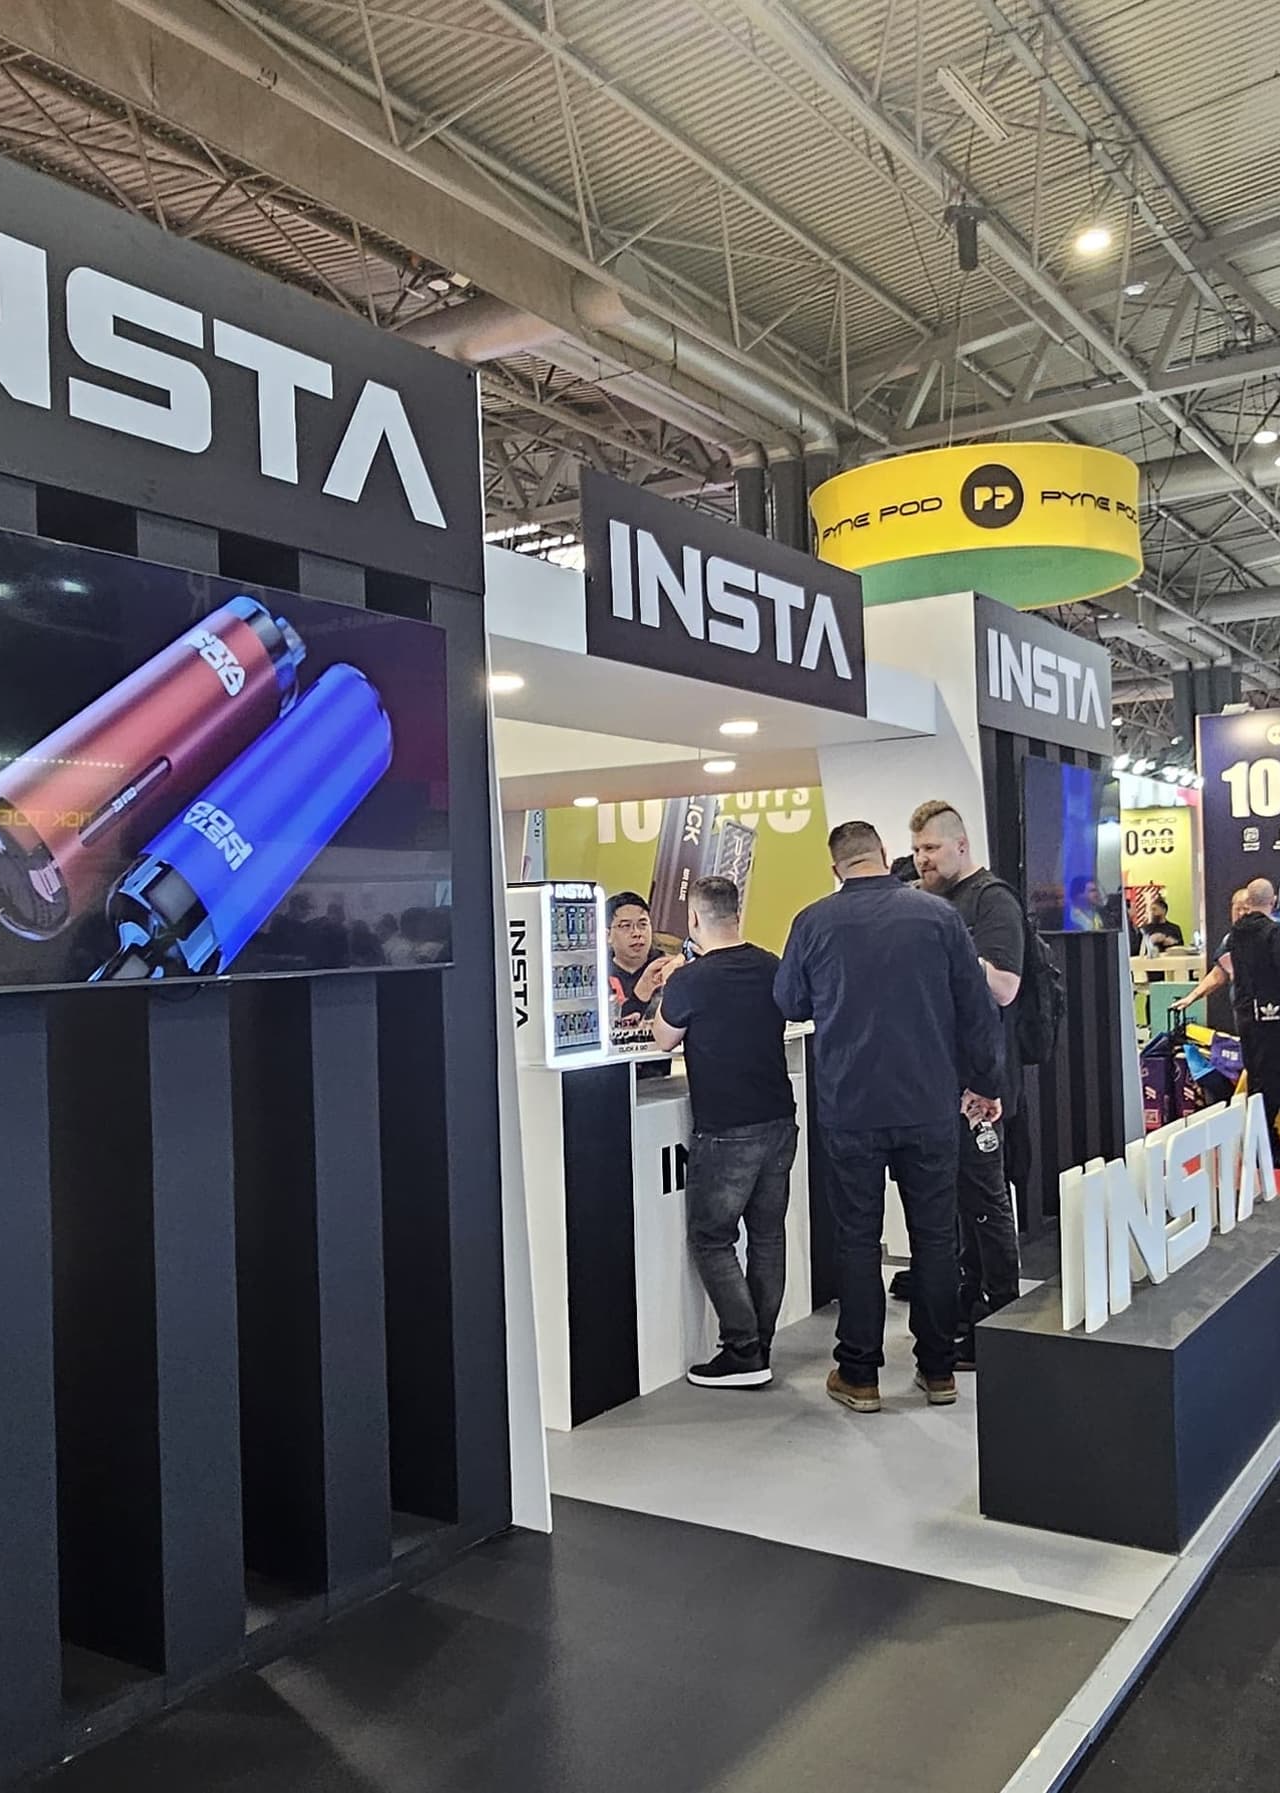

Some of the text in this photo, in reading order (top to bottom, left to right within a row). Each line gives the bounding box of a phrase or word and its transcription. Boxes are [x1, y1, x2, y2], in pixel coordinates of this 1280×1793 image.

[822, 496, 942, 541] PYNE POD
[1040, 490, 1111, 512] PYNE
[609, 518, 852, 680] INSTA
[987, 627, 1105, 728] INSTA
[554, 883, 593, 899] INSTA
[509, 920, 528, 1028] INSTA
[1059, 1092, 1277, 1334] INSTA
